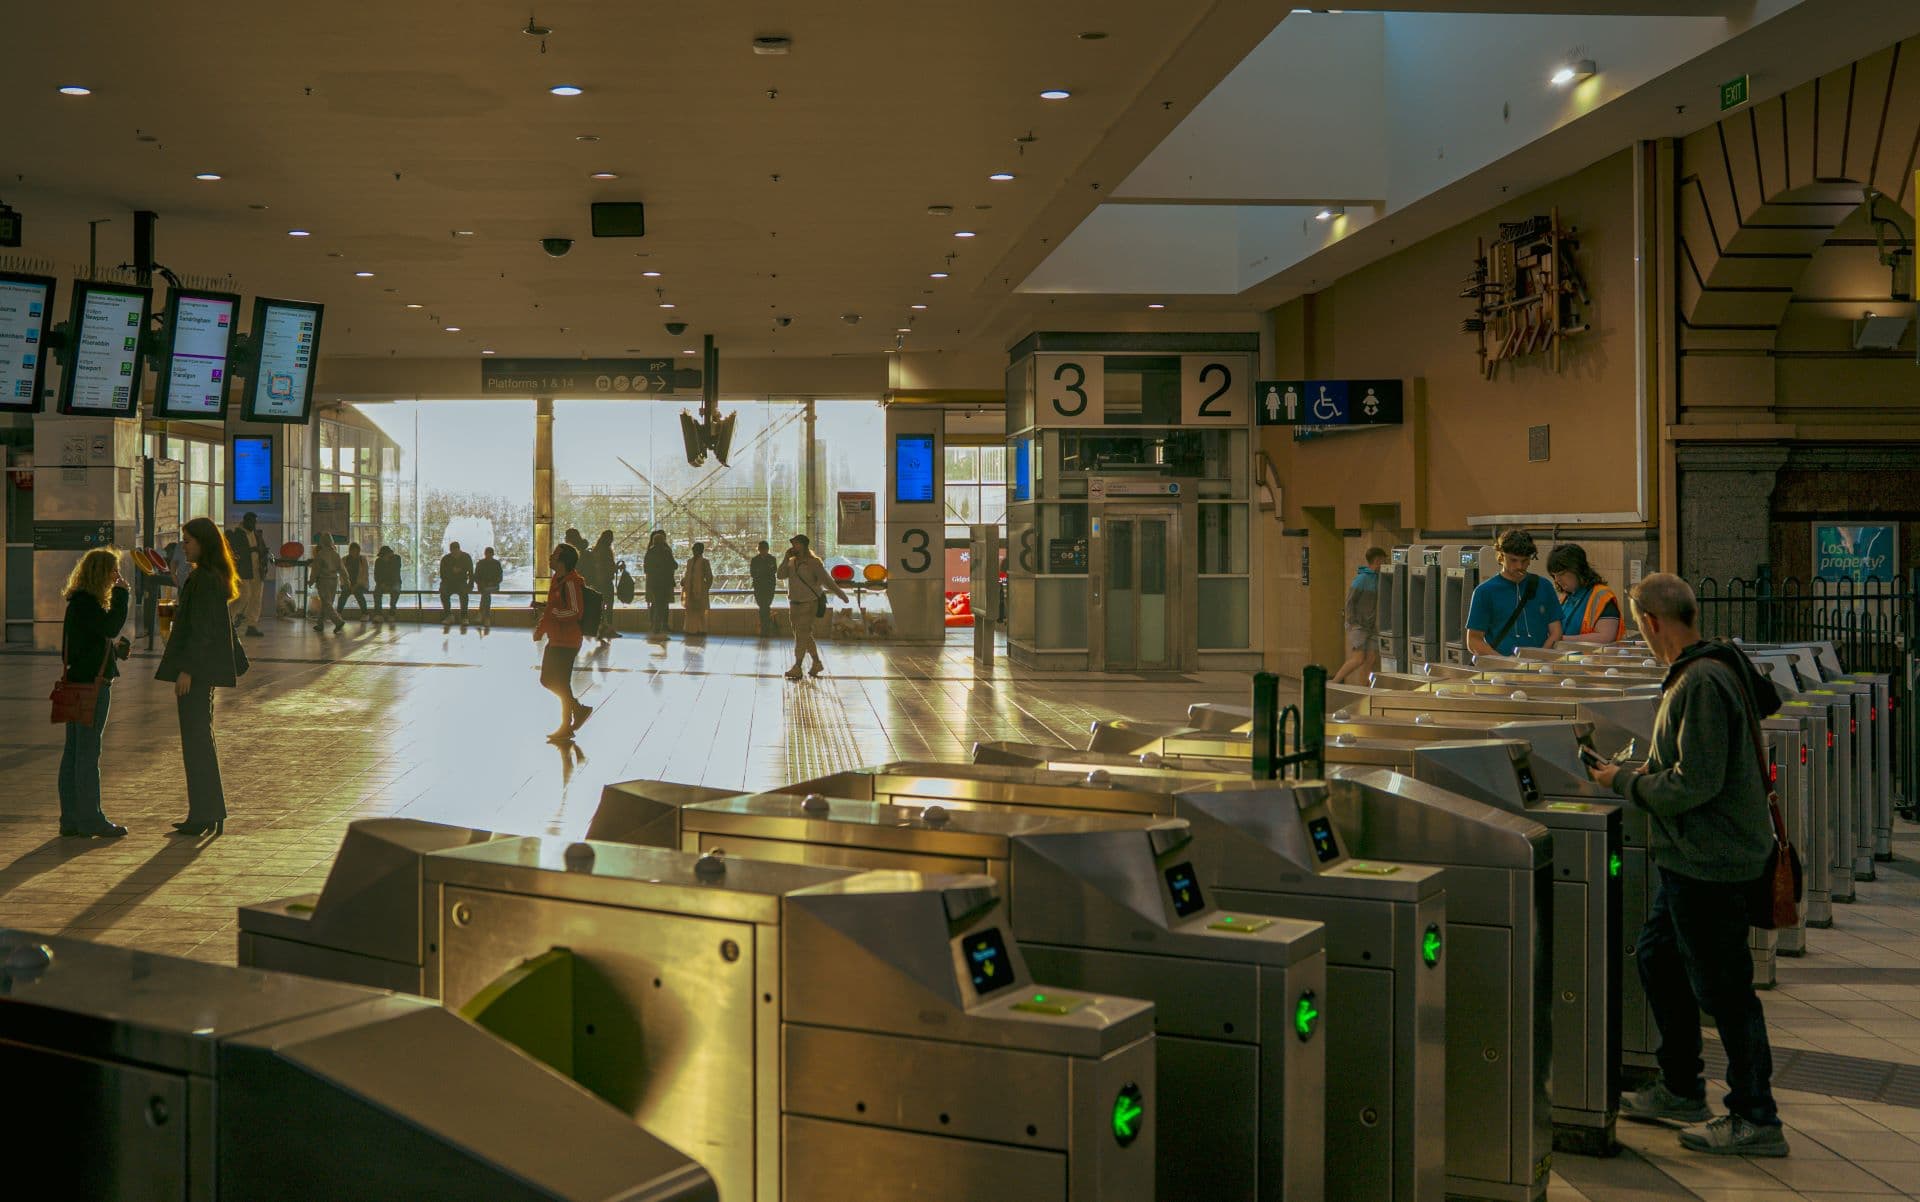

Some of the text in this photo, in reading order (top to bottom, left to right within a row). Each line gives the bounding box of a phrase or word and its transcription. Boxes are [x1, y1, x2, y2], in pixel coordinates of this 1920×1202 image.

[1726, 82, 1742, 104] EXIT
[488, 378, 538, 389] Platforms
[550, 378, 559, 389] &
[562, 378, 574, 389] 14
[1052, 362, 1088, 417] 3
[1197, 363, 1232, 417] 2
[901, 528, 932, 573] 3
[1820, 555, 1886, 571] property?
